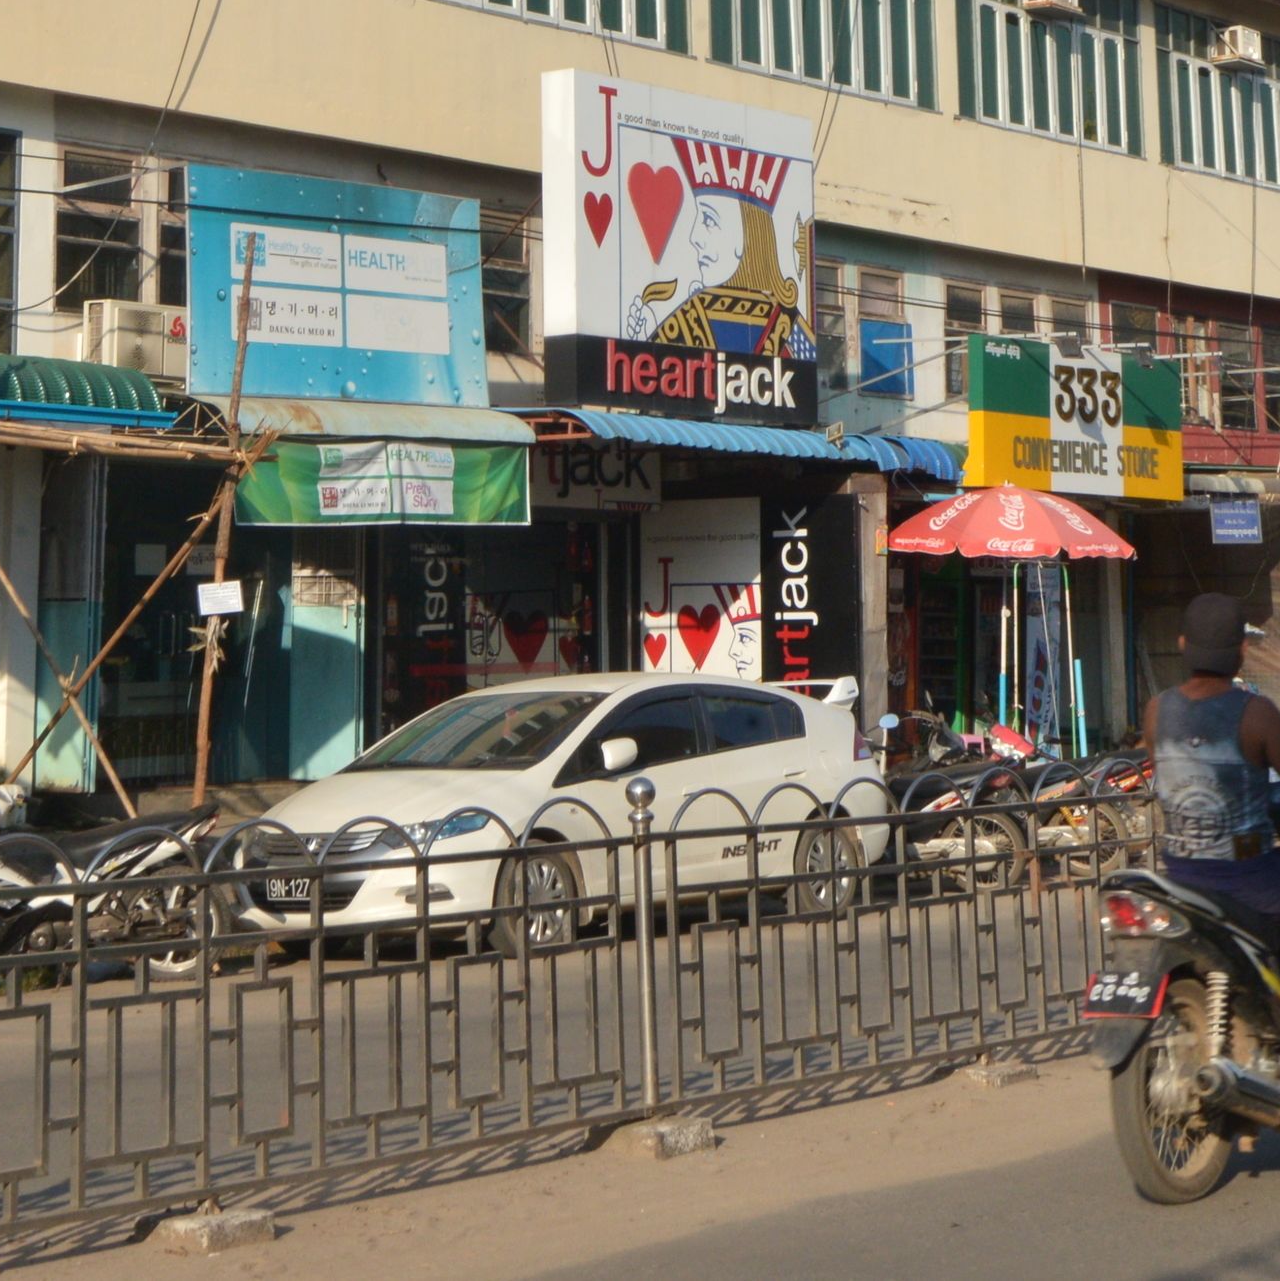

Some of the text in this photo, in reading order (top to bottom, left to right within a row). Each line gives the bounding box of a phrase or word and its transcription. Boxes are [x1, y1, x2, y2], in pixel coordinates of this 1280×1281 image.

[581, 85, 618, 177] J
[624, 113, 643, 125] good
[645, 118, 661, 128] man
[663, 120, 686, 134] knows
[687, 125, 699, 136] the
[701, 129, 720, 143] good
[722, 131, 745, 146] quality
[1053, 364, 1122, 428] 333
[1012, 434, 1160, 481] CONVENIENCE STORE
[269, 878, 311, 898] 9N-127
